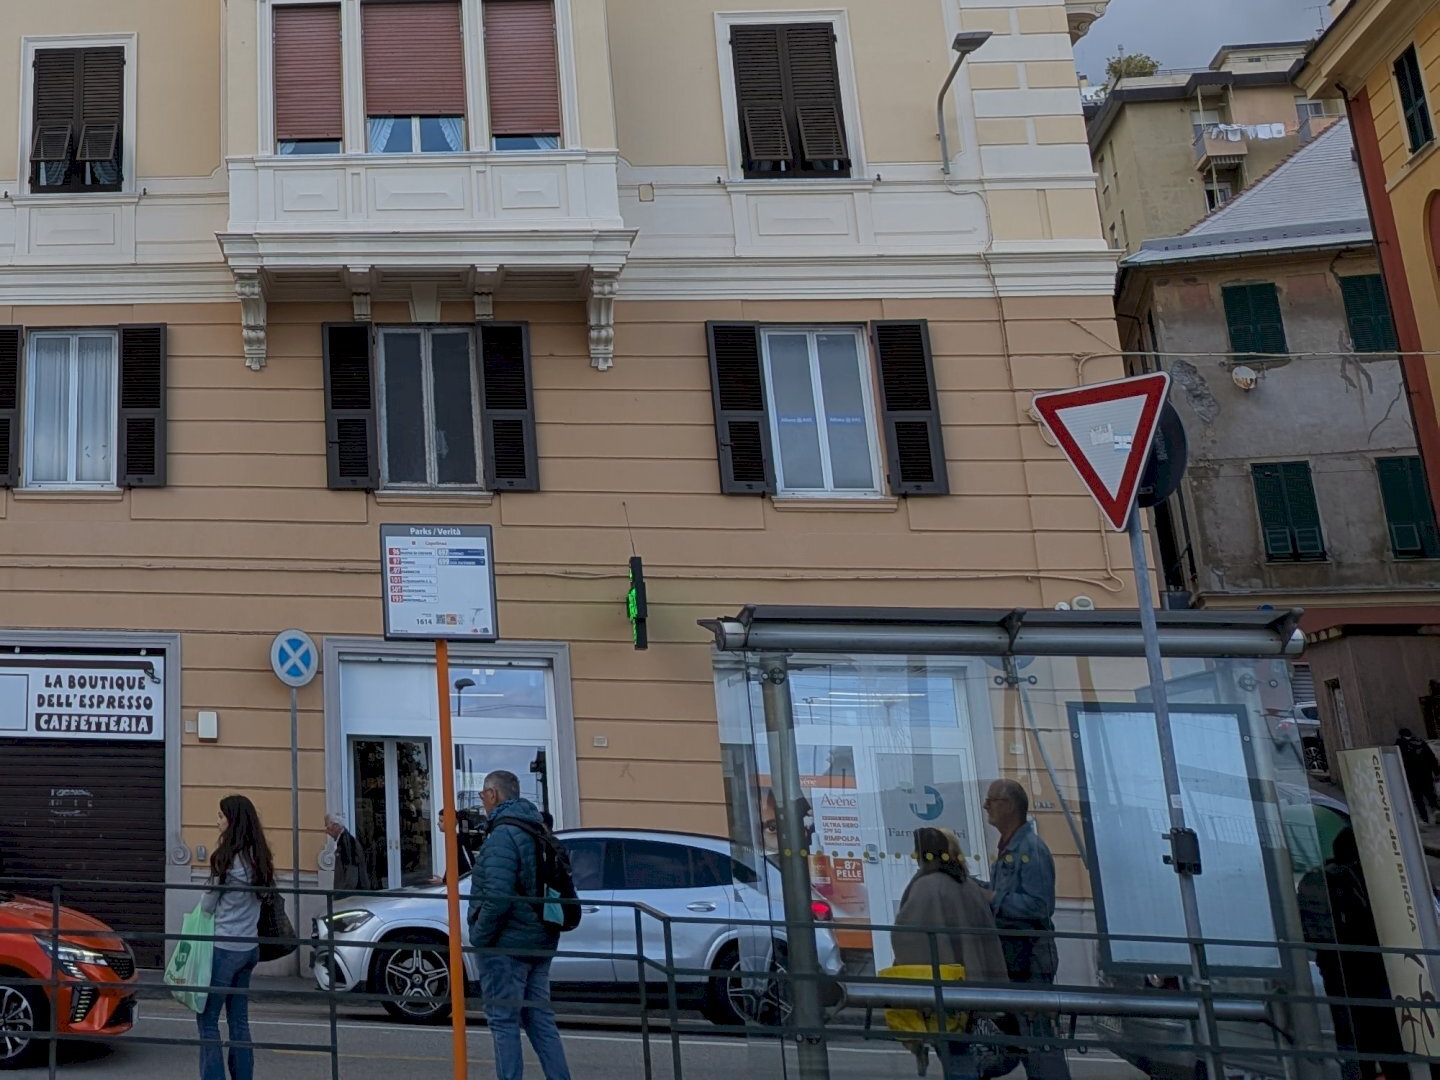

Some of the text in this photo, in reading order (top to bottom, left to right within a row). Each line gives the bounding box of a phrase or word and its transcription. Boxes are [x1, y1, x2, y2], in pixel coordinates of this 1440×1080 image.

[409, 527, 432, 535] Parks
[437, 527, 461, 536] Verità
[45, 674, 146, 692] LA BOUTIQUE
[36, 693, 153, 710] DELL'ESPRESSO
[39, 714, 149, 732] CAFFETTERIA
[820, 793, 857, 807] Avène
[836, 869, 862, 878] PELLE
[1388, 828, 1401, 857] del
[1396, 862, 1417, 933] BEIGUA
